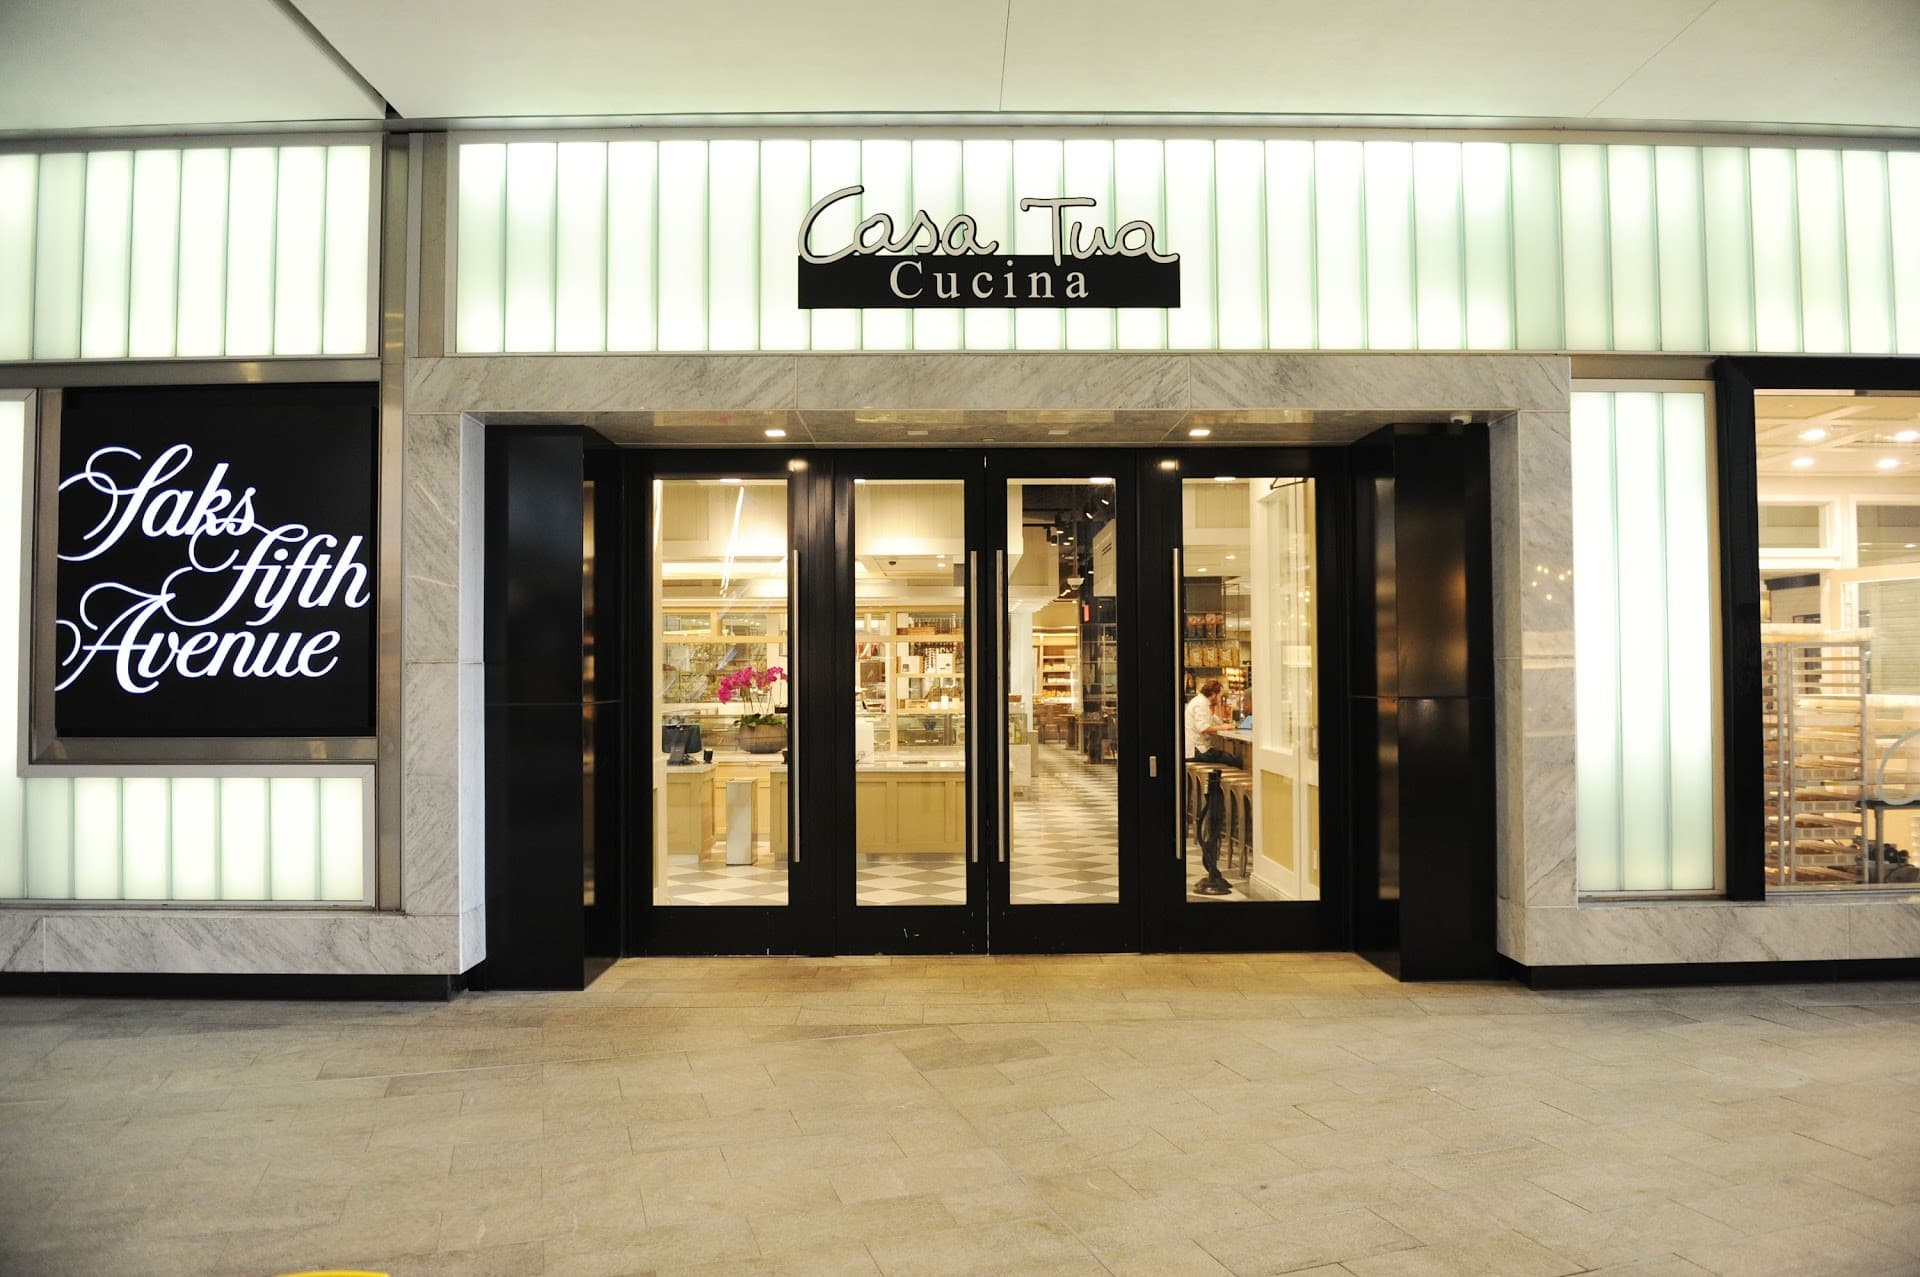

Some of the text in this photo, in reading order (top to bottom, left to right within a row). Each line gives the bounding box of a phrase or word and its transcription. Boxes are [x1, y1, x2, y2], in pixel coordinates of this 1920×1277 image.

[799, 185, 1180, 266] Casa Tua
[889, 259, 1089, 299] Cucina
[57, 444, 256, 561] Saks
[161, 518, 371, 627] Fifth
[55, 582, 341, 693] Avenue
